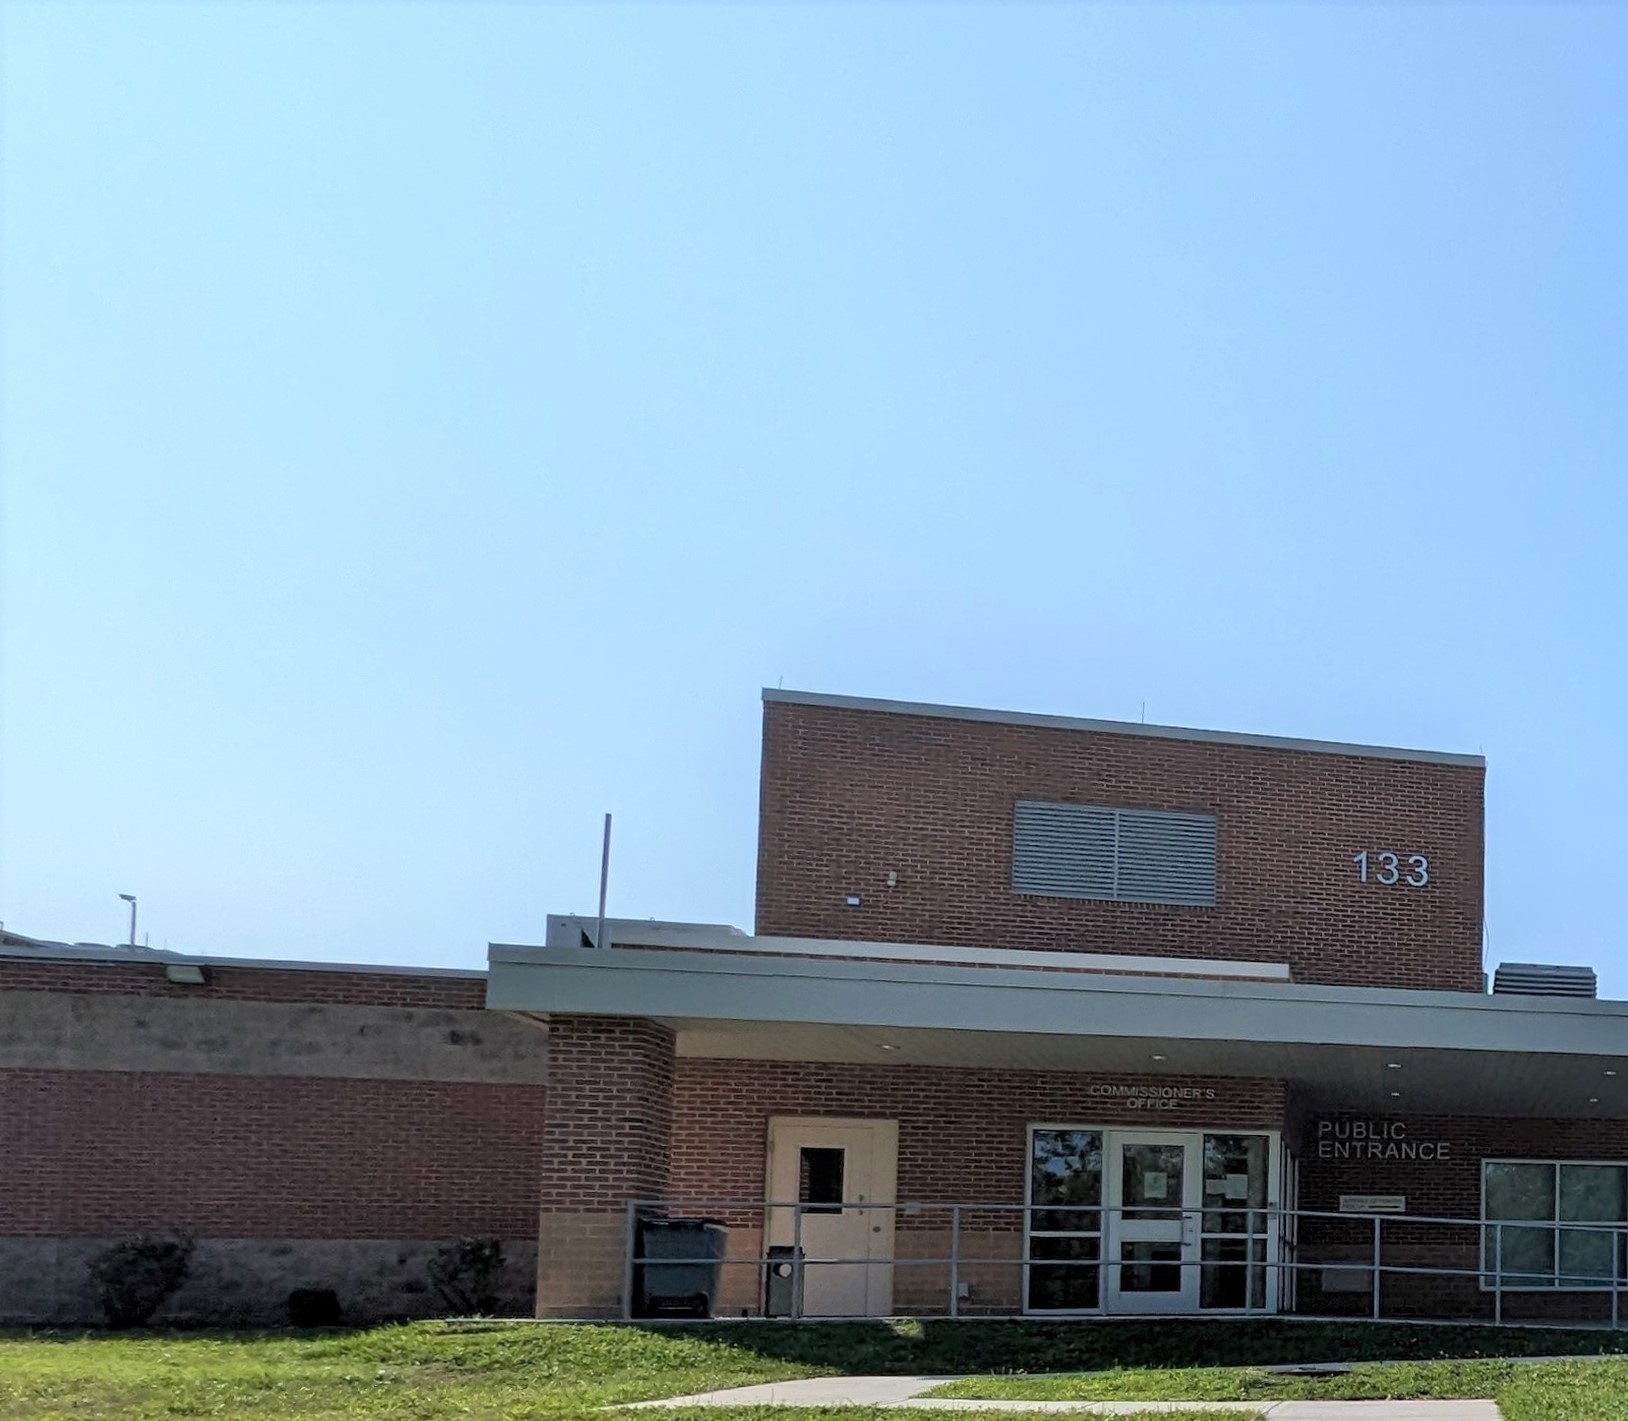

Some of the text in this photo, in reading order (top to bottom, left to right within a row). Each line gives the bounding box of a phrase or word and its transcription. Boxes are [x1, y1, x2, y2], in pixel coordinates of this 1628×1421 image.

[1353, 850, 1429, 887] 133
[1090, 1084, 1215, 1099] COMMISSIONER'S
[1126, 1098, 1180, 1109] OFFICE
[1319, 1121, 1406, 1139] PUBLIC
[1319, 1141, 1450, 1159] ENTRANCE
